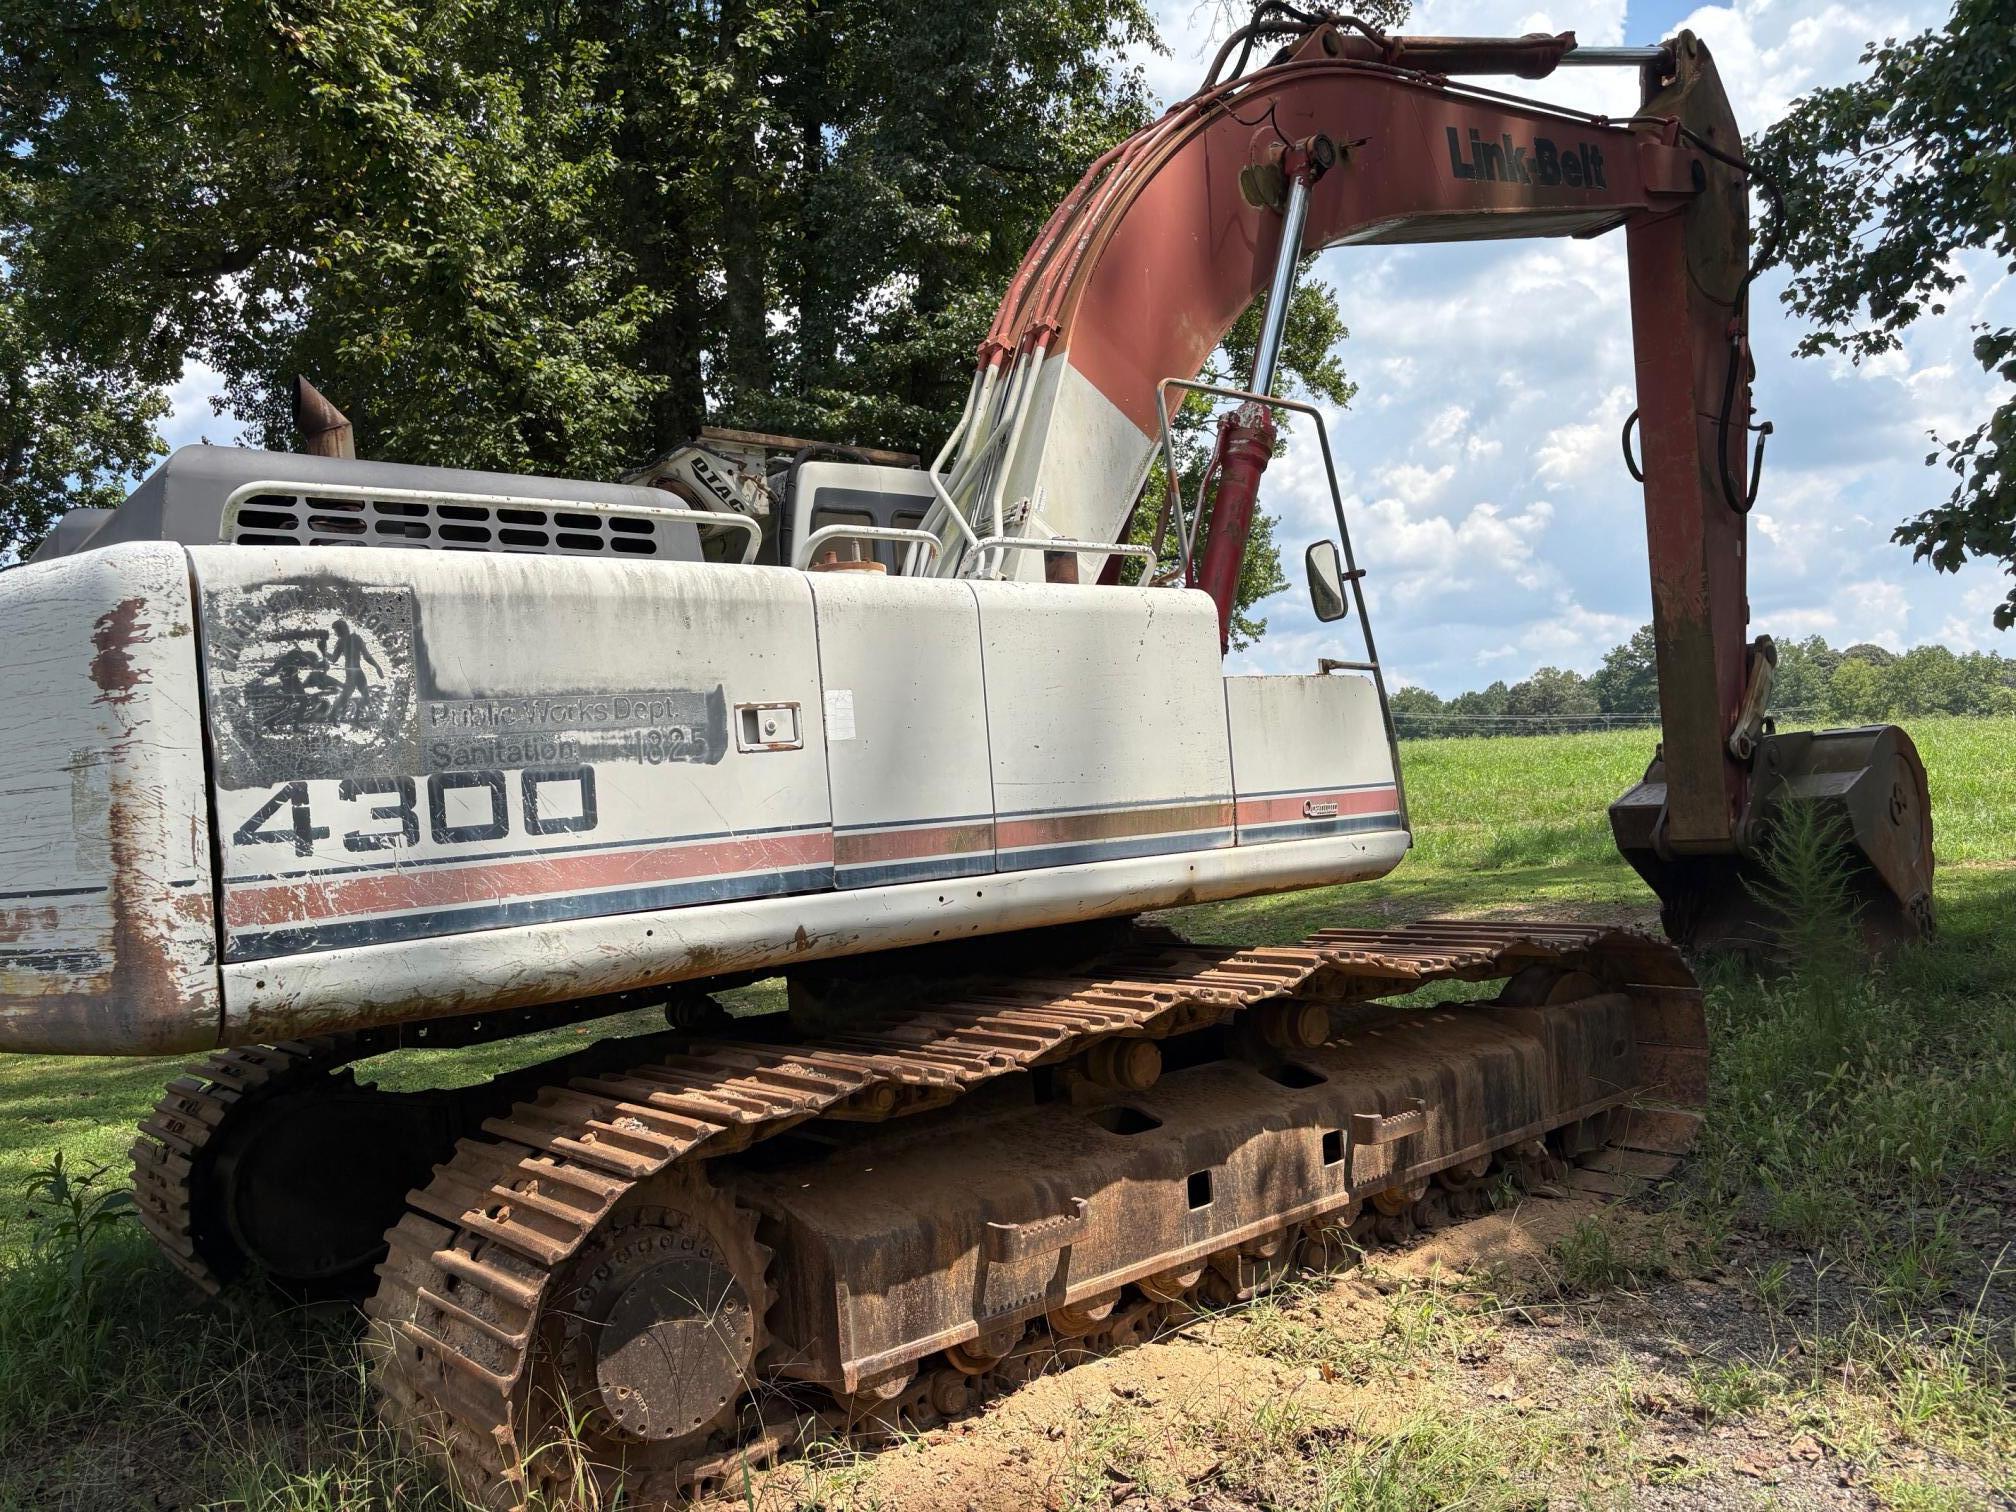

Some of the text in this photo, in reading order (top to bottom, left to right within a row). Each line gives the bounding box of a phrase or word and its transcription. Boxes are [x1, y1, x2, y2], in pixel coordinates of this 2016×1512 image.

[1446, 127, 1607, 190] Link-Belt
[431, 696, 679, 726] Public Works Dept.
[431, 740, 576, 767] Sanitation
[232, 763, 599, 858] 4300
